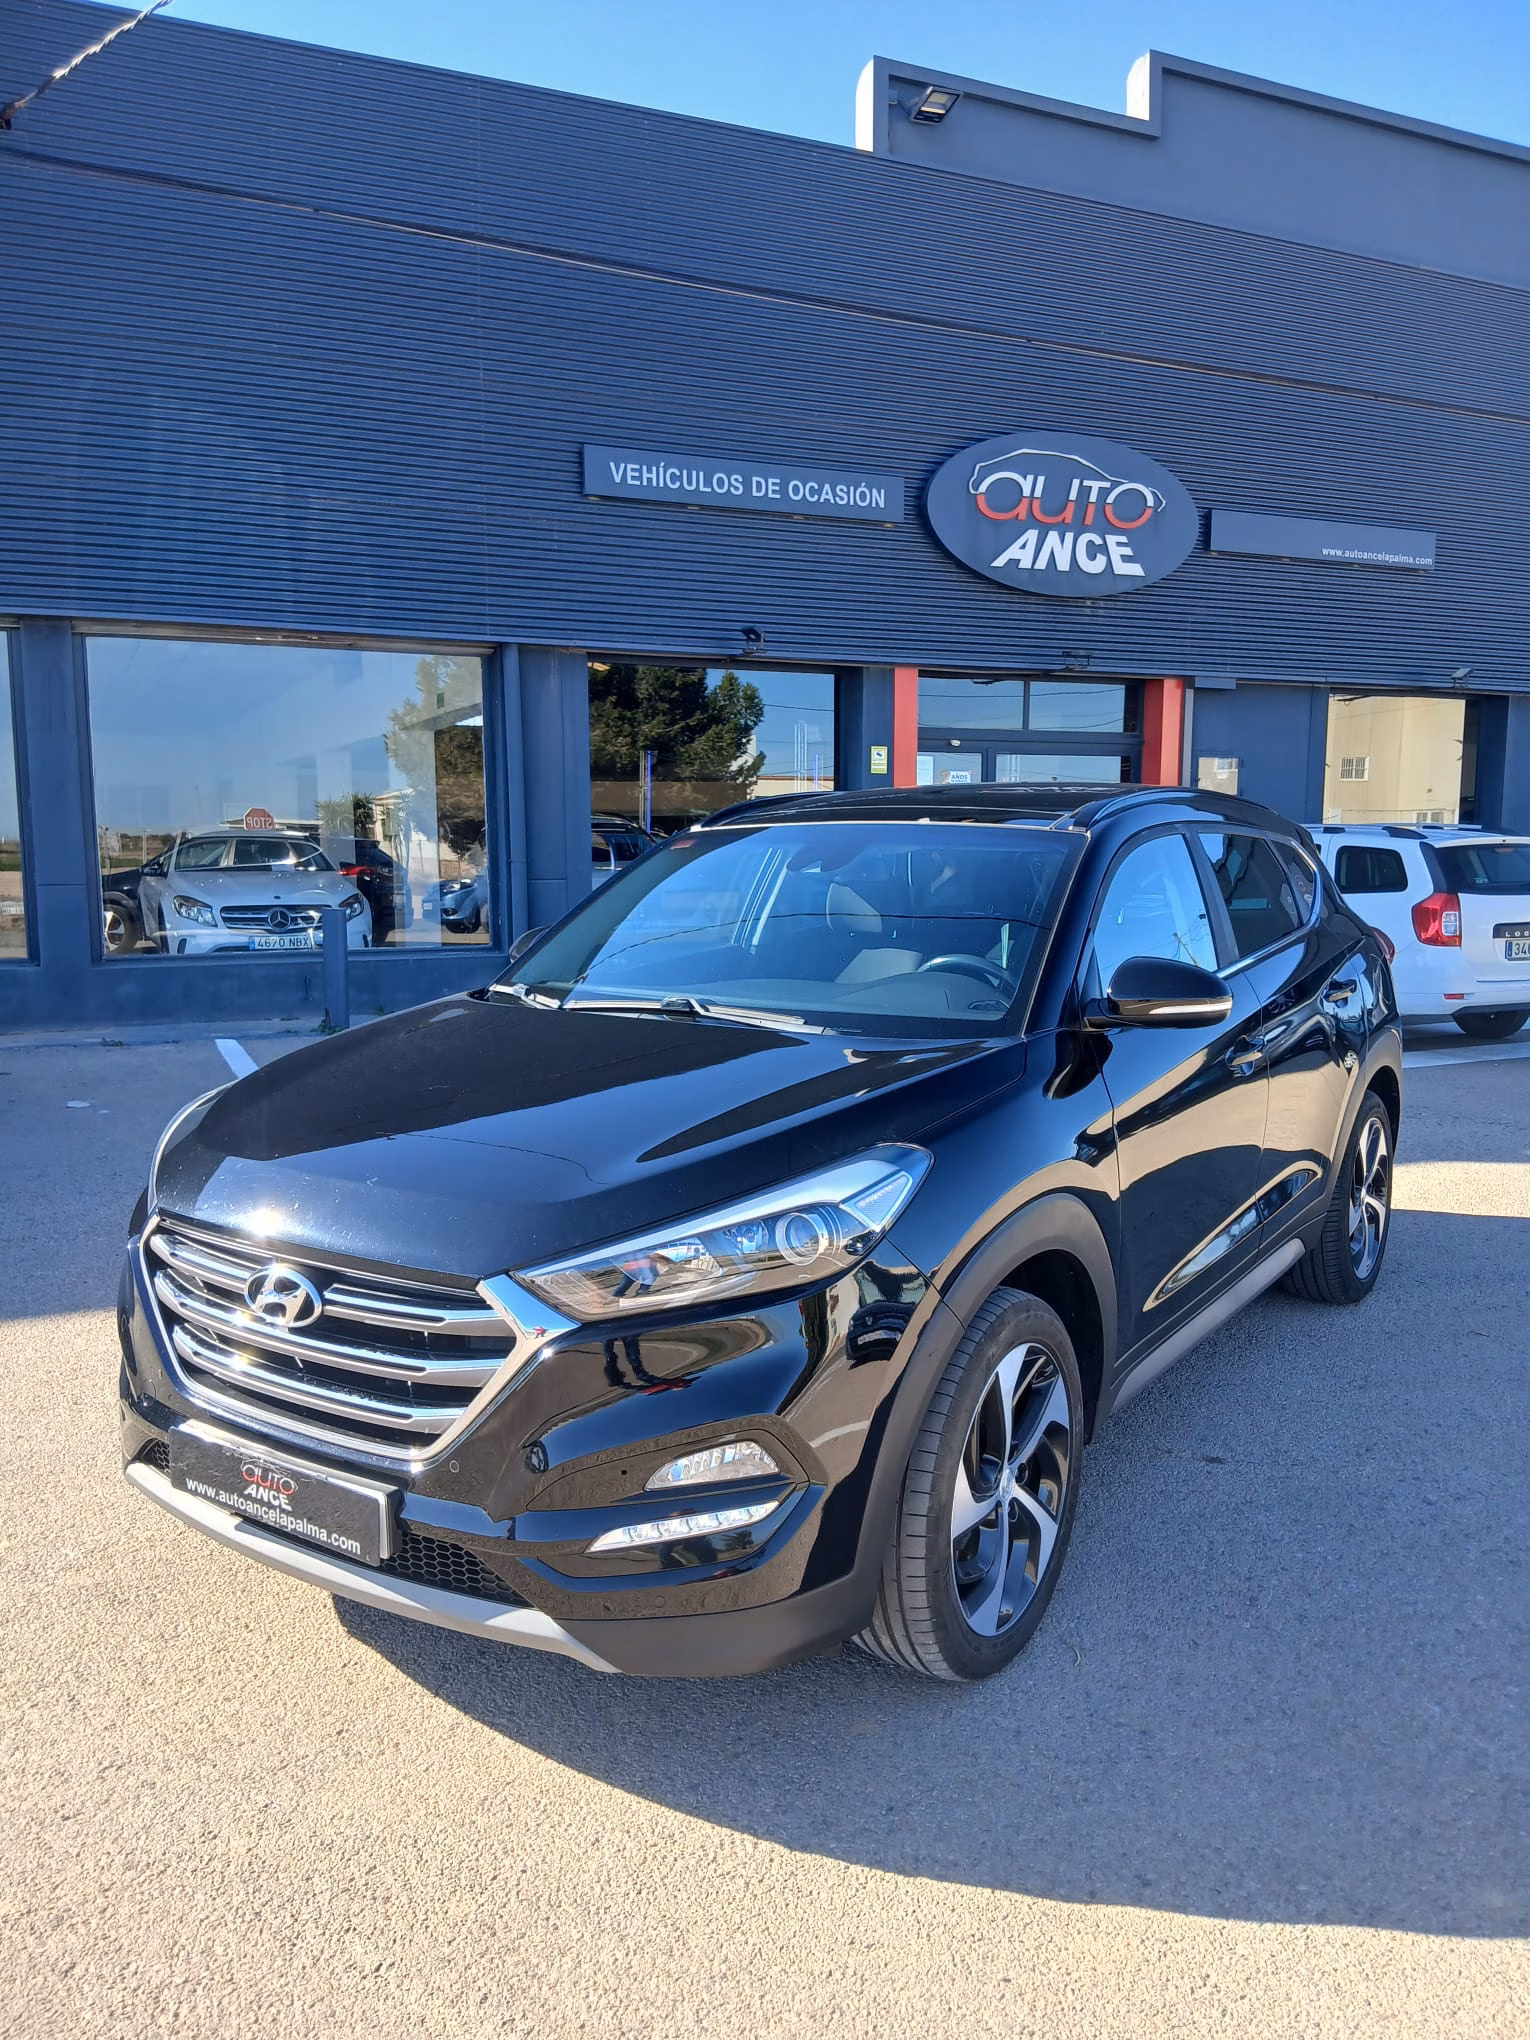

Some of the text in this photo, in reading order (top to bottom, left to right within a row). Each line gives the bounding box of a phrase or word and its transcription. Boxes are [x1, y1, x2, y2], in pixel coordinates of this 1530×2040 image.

[609, 461, 886, 508] VEHÍCULOS DE OCASIÓN
[989, 529, 1146, 577] ANCE
[1321, 547, 1433, 566] www.autoancelapalma.com
[289, 937, 309, 948] NBX
[1514, 942, 1530, 955] 34
[243, 1483, 293, 1511] ANCE
[185, 1477, 361, 1555] www.autoancelapalma.com
